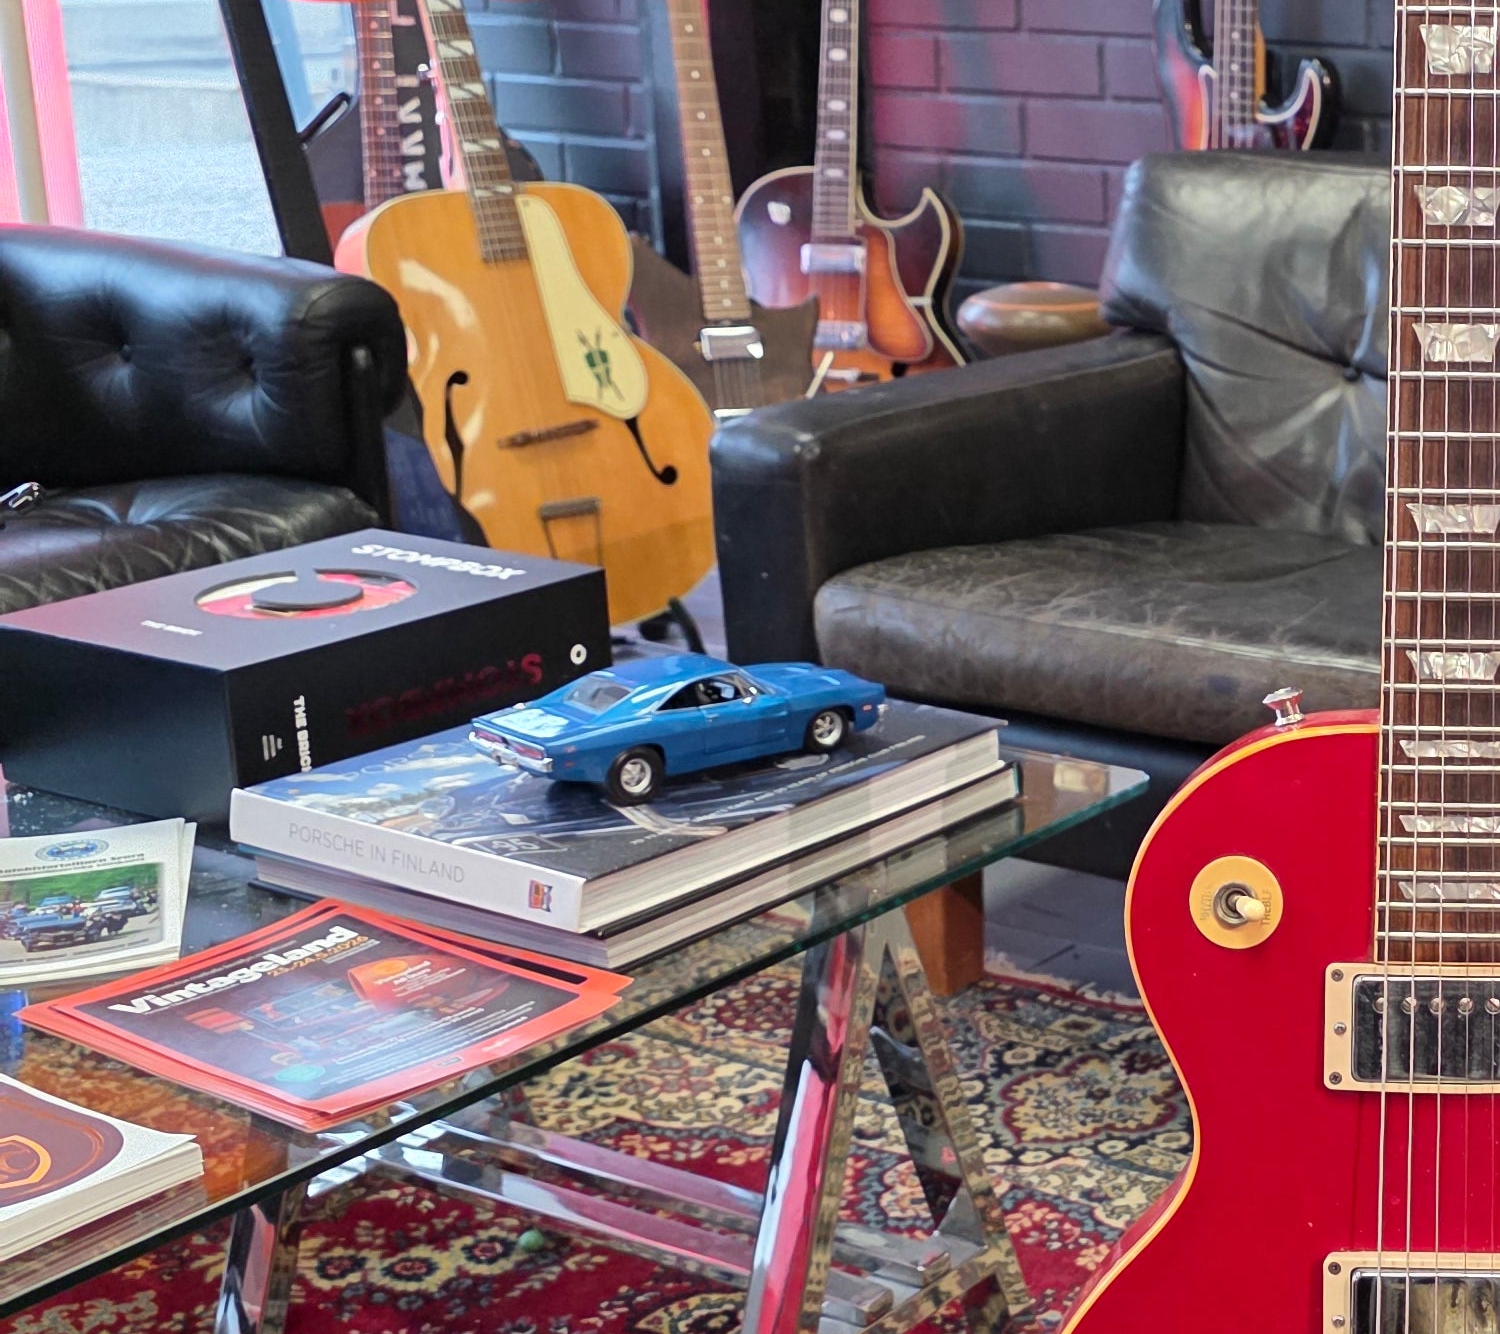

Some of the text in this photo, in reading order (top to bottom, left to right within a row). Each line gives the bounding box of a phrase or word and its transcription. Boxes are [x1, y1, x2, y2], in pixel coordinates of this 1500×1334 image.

[352, 543, 527, 581] STOMPBOX
[293, 695, 307, 729] THE
[289, 822, 465, 884] PORSCHE IN FINLAND
[108, 925, 359, 1014] Vintageland
